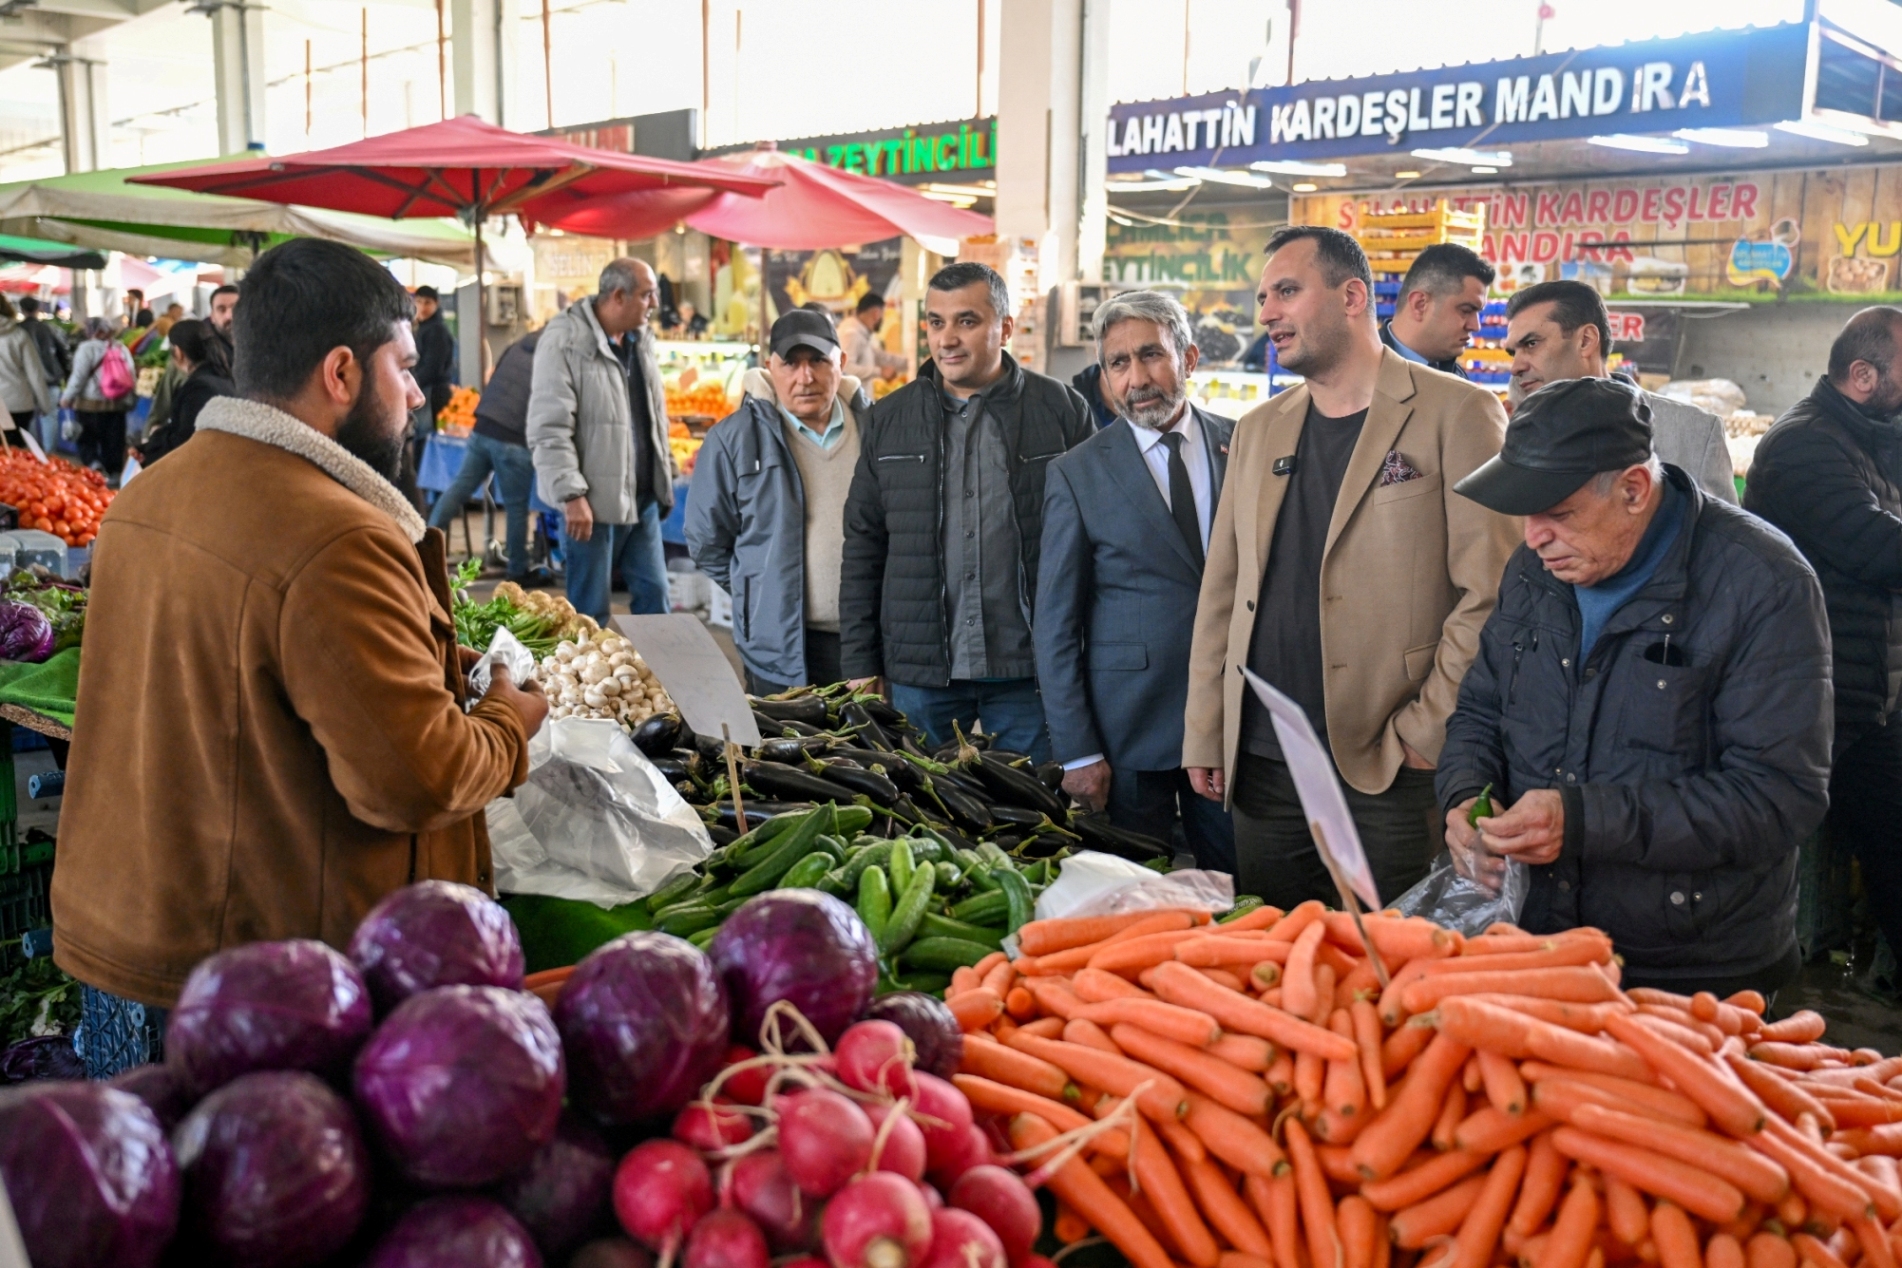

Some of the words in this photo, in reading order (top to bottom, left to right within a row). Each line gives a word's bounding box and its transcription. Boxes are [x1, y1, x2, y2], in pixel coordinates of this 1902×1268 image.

[1270, 82, 1484, 145] KARDEŞLER
[1494, 61, 1711, 124] MANDIRA
[1537, 184, 1759, 230] KARDEŞLER
